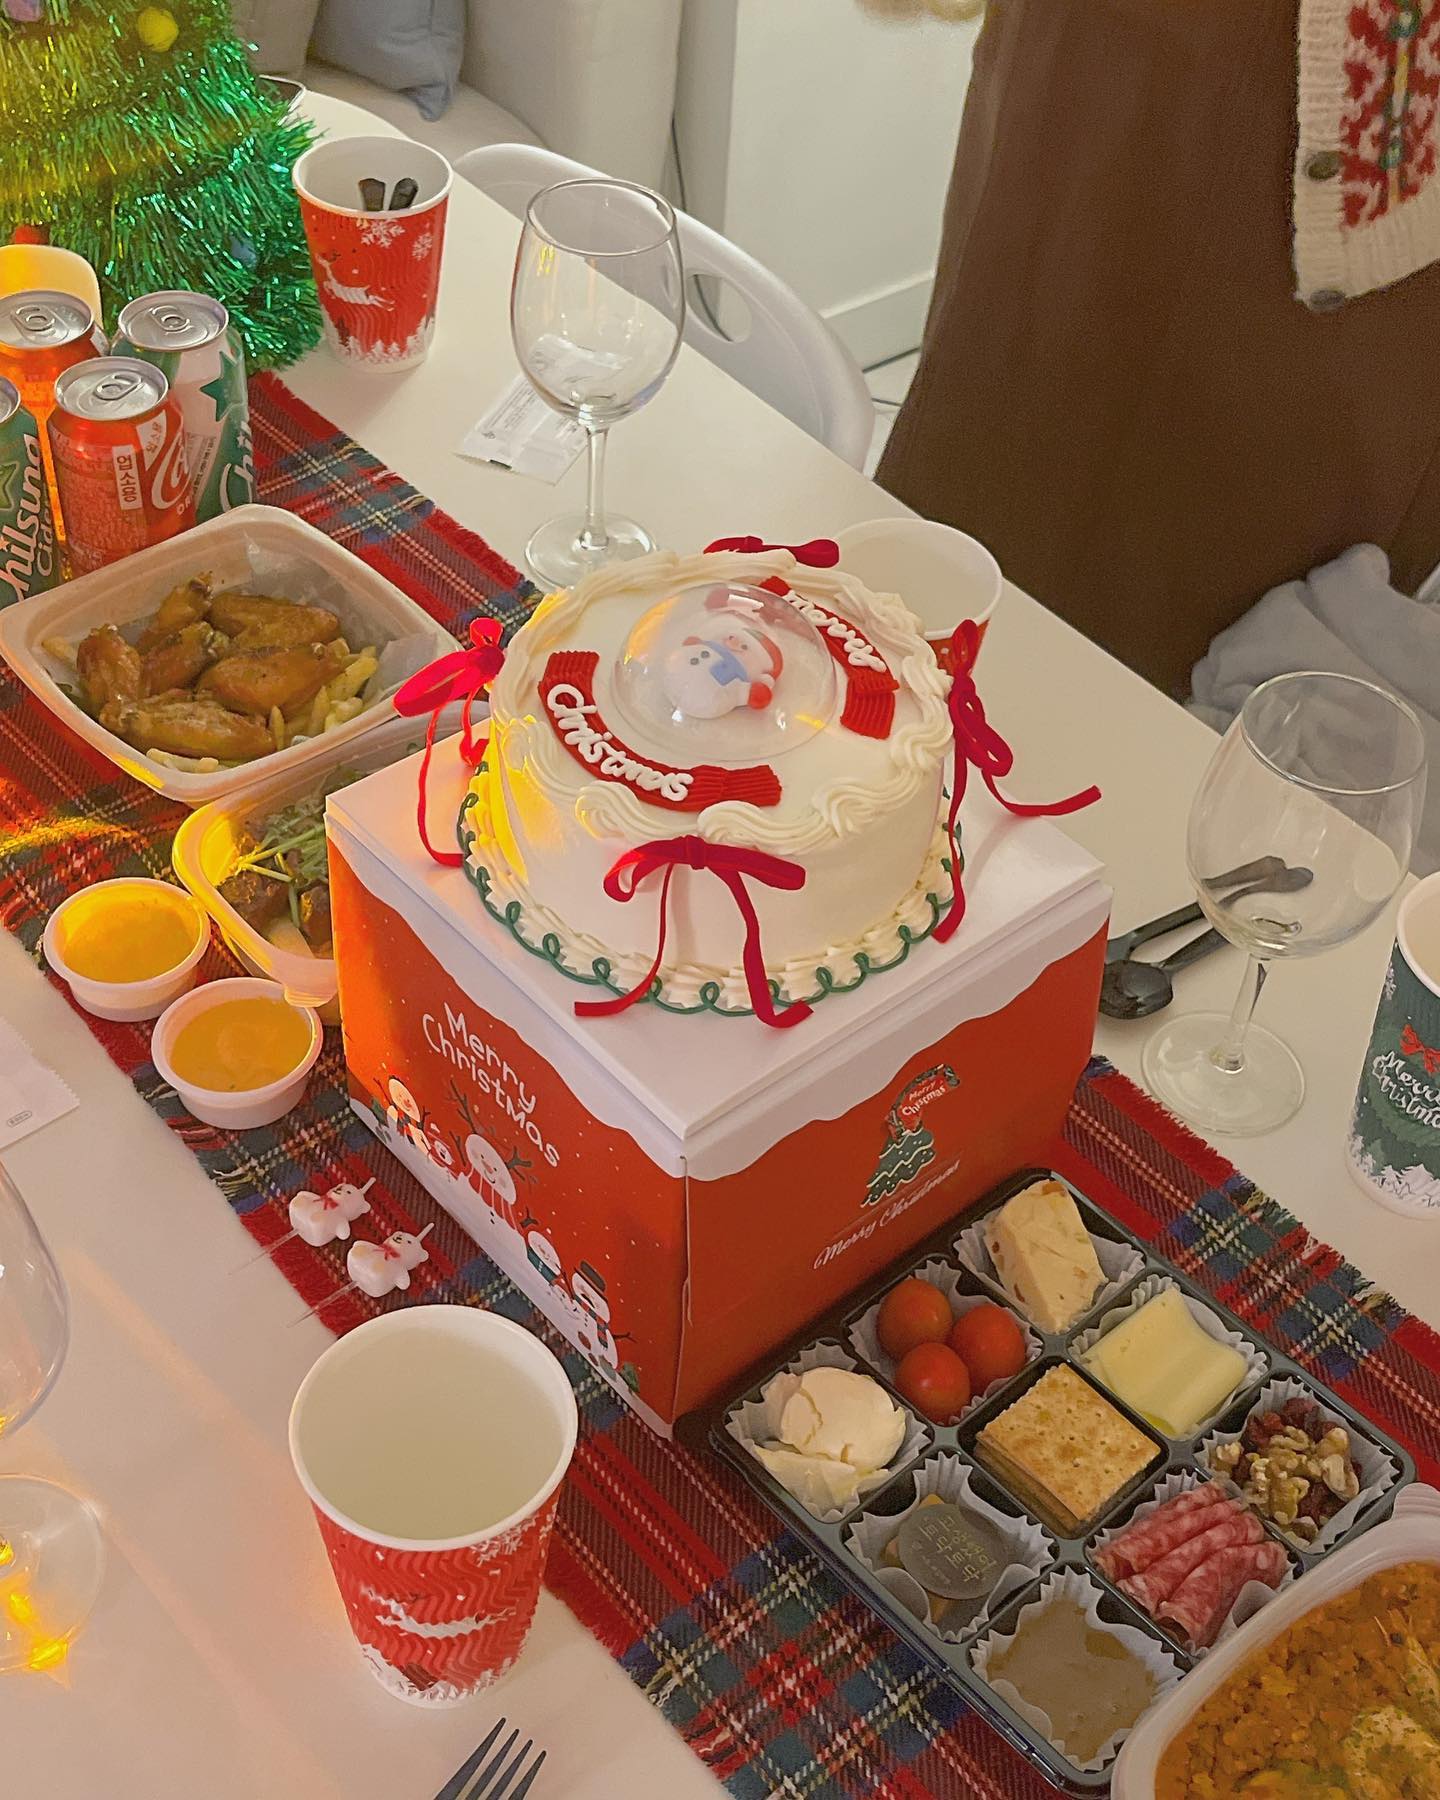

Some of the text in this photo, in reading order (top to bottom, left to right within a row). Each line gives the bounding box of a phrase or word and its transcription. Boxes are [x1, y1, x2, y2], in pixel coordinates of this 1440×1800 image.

[116, 454, 137, 503] 업소용
[546, 683, 694, 802] Christmas
[443, 1001, 537, 1114] Merry
[813, 1160, 961, 1270] Merry Christmas
